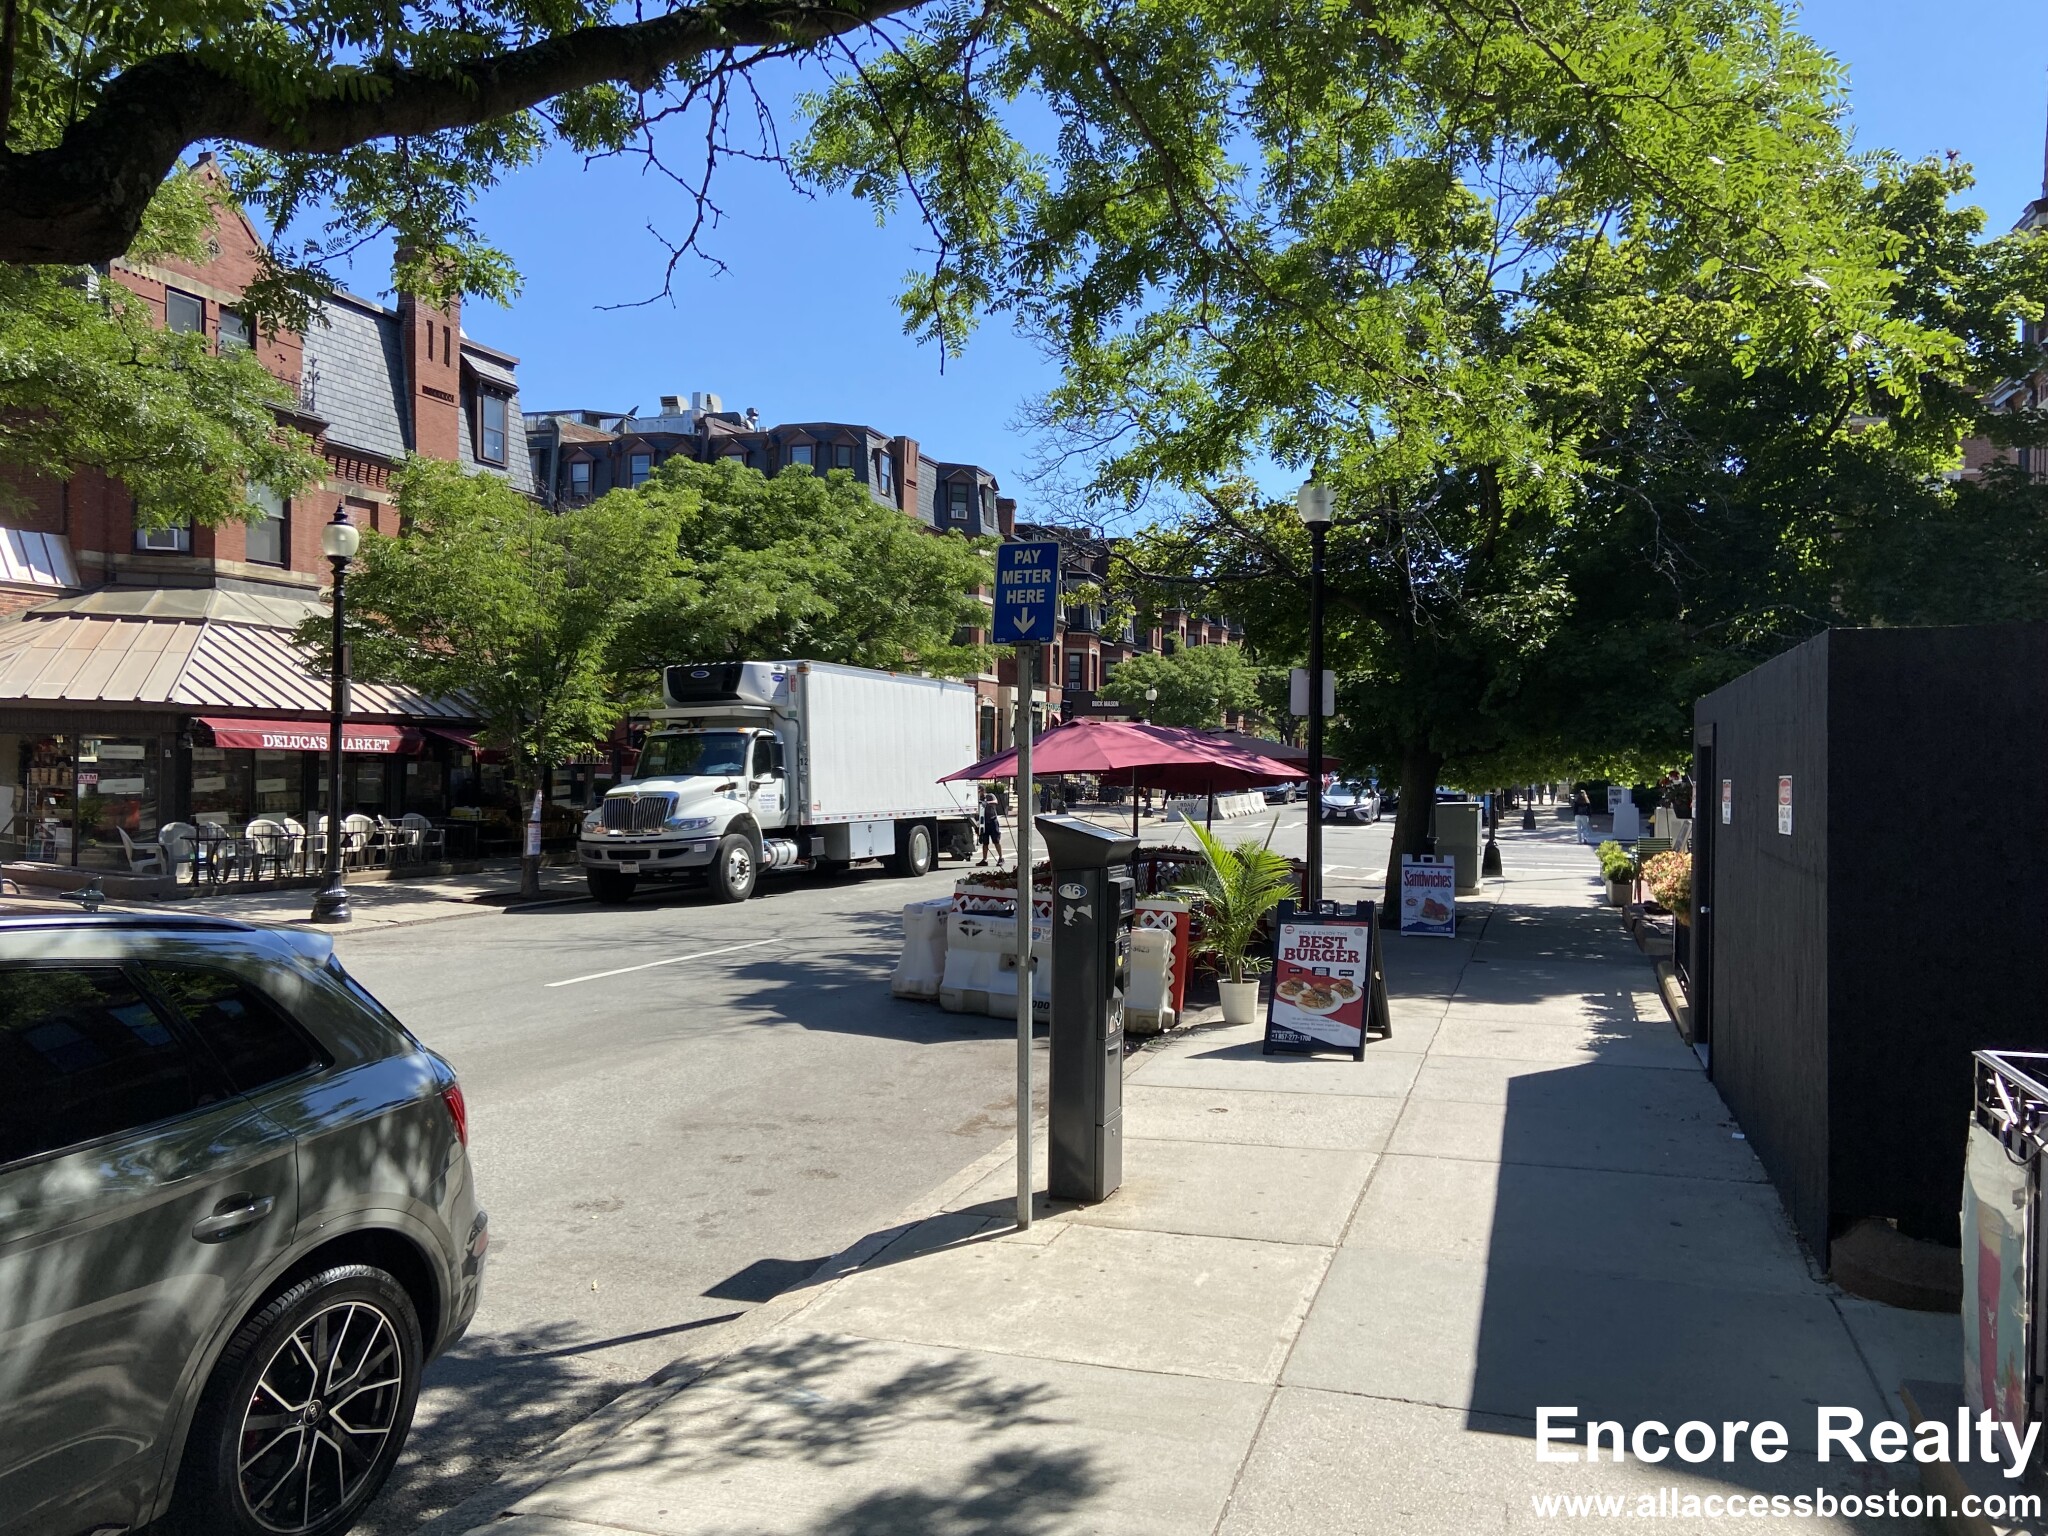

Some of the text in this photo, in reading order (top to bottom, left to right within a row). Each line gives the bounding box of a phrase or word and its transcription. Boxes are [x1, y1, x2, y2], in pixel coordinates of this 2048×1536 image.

[1014, 549, 1041, 564] PAY
[1002, 569, 1051, 584] METER
[1006, 589, 1045, 604] HERE
[262, 734, 328, 750] DELUCA'S
[800, 758, 808, 766] 12
[1404, 870, 1452, 888] Sandwiches
[1298, 936, 1347, 949] BEST
[1283, 948, 1361, 963] BURGER
